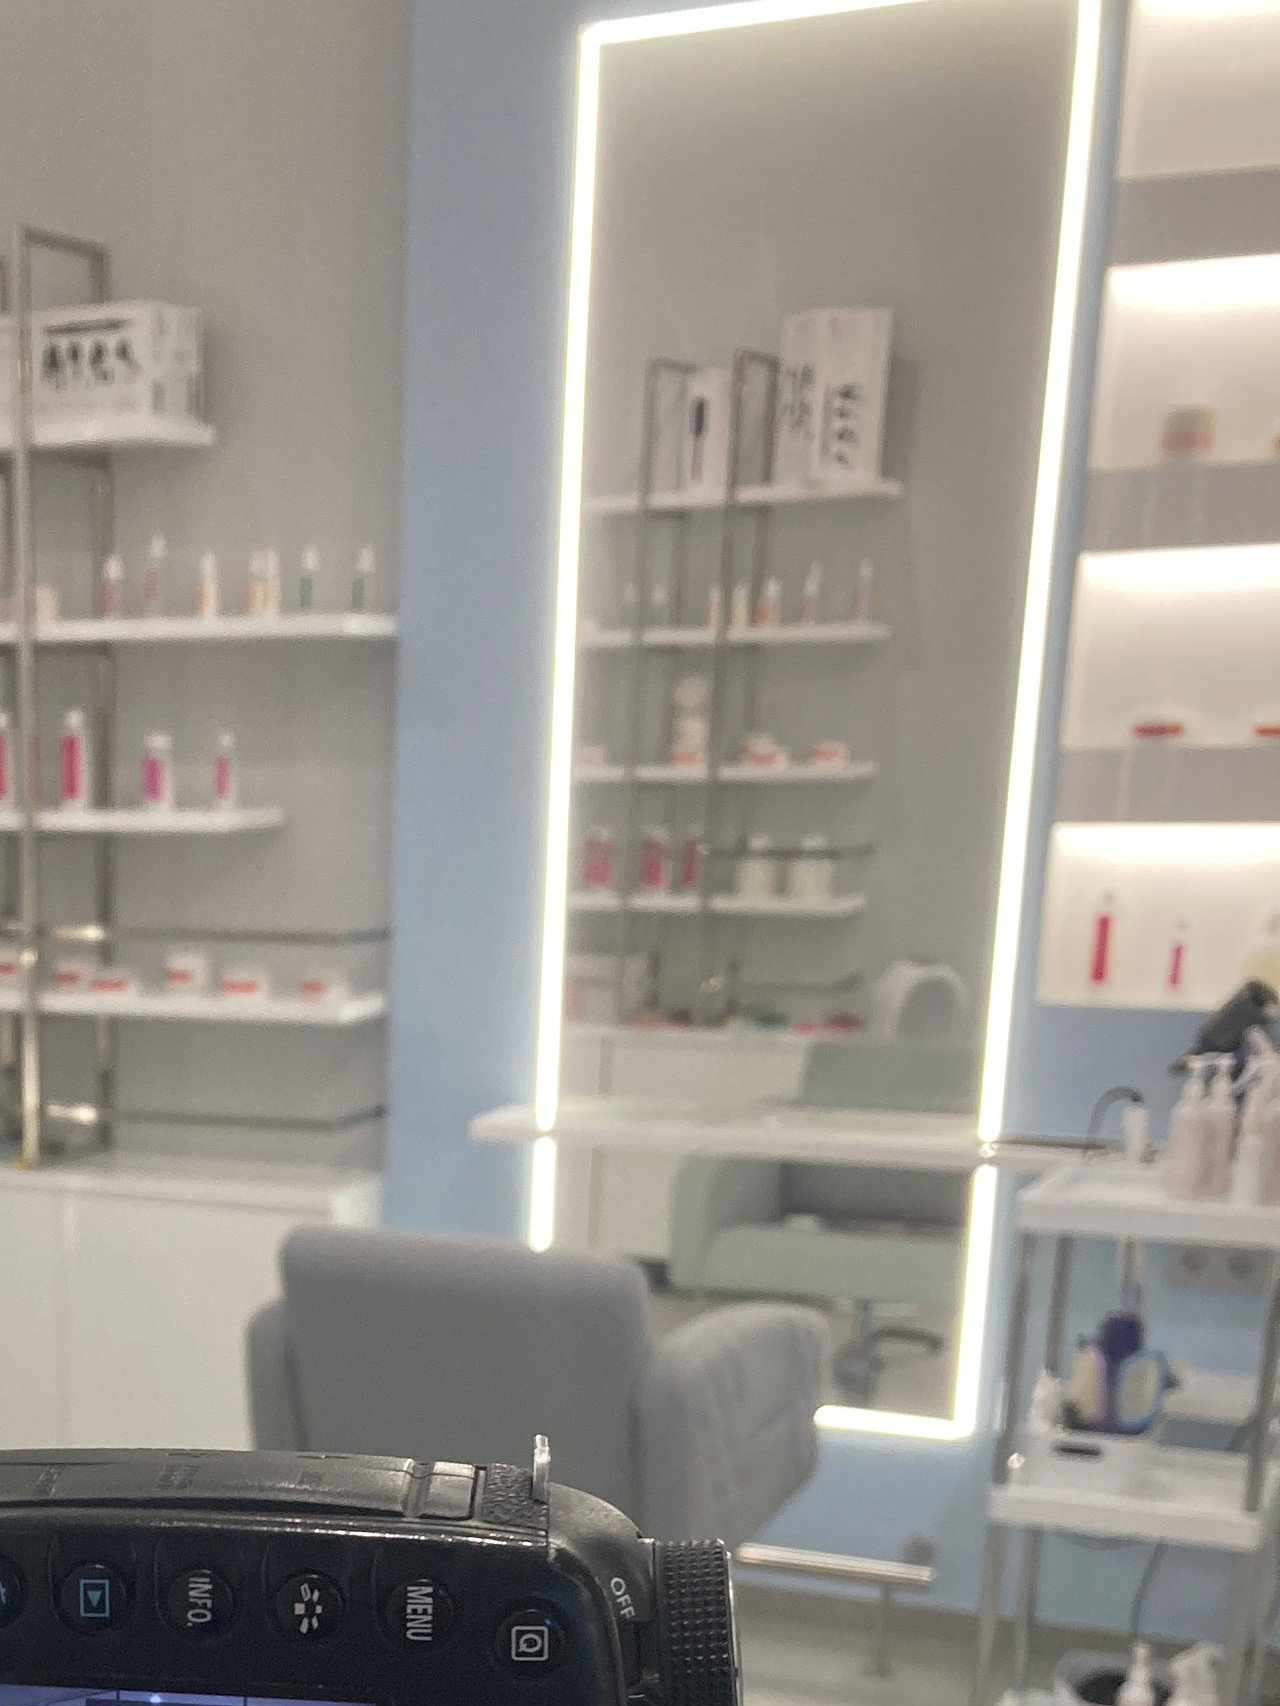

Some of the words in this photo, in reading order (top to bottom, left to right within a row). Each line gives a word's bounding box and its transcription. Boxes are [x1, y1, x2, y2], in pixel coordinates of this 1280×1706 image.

[186, 1577, 213, 1627] INFO.
[406, 1586, 433, 1641] MENU
[610, 1577, 635, 1619] OFF
[519, 1633, 542, 1652] Q
